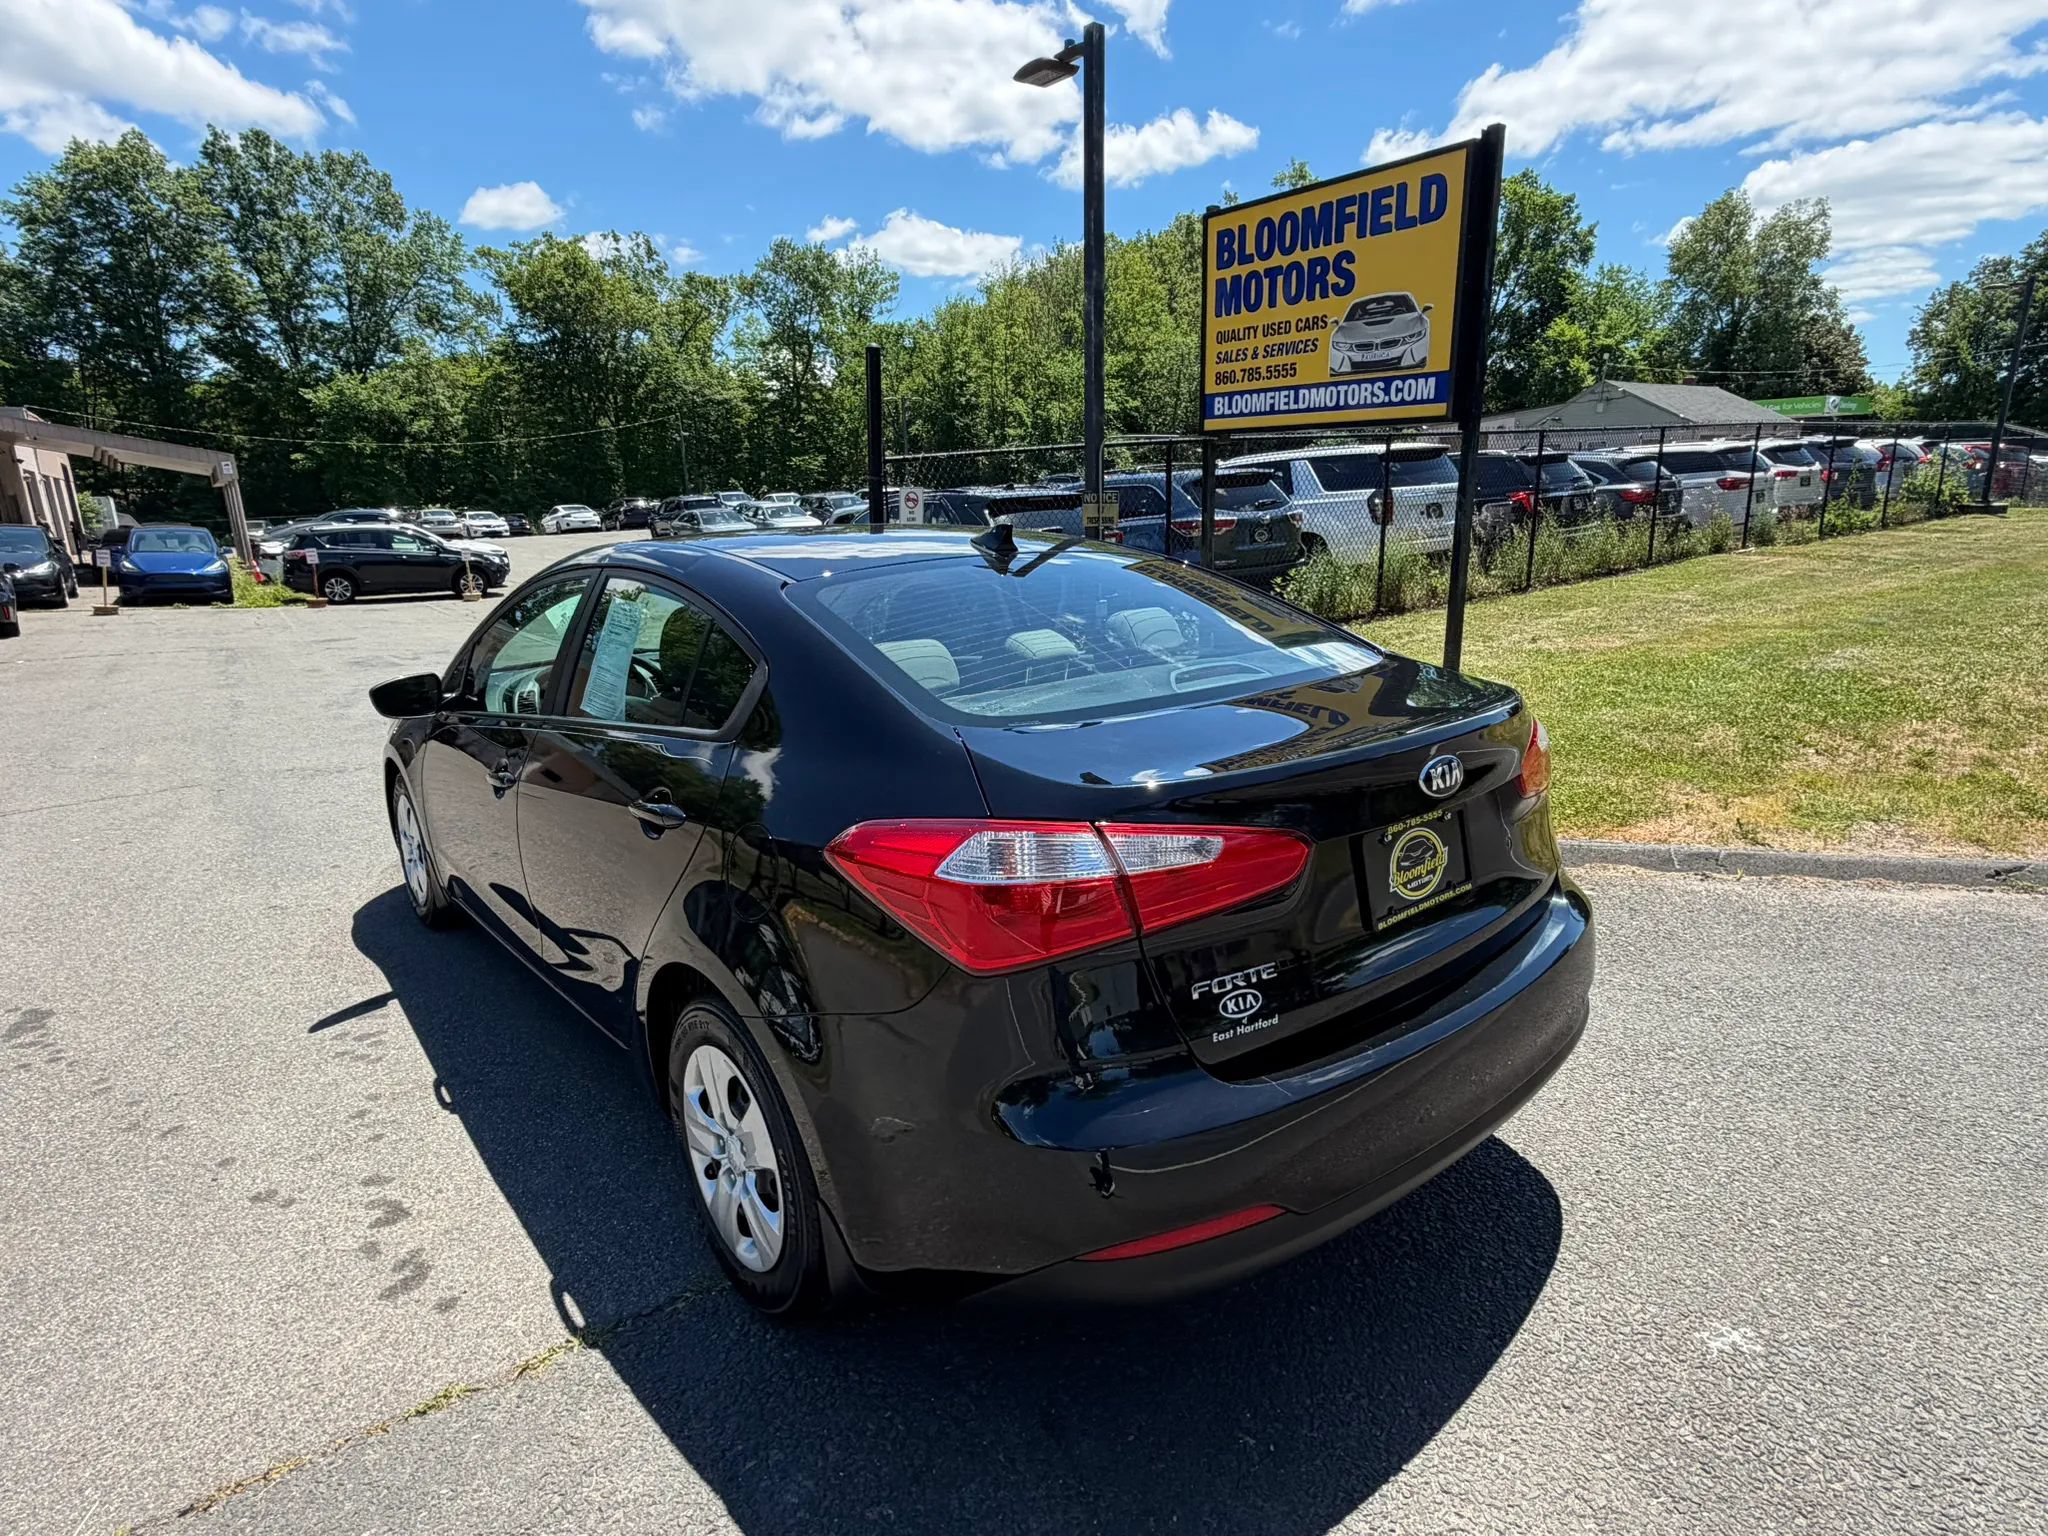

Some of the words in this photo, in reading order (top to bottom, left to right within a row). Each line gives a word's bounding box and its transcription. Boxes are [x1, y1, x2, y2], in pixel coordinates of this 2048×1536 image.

[1216, 172, 1448, 271] BLOOMFIELD
[1215, 249, 1356, 318] MOTORS
[1216, 325, 1259, 345] QUALITY
[1262, 320, 1292, 338] USED
[1295, 314, 1329, 333] CARS
[1215, 347, 1249, 365] SALES
[1251, 346, 1260, 360] &
[1262, 337, 1319, 359] SERVICES
[1215, 362, 1298, 386] 860.785.5555
[1214, 376, 1436, 416] BLOOMFIELDMOTORS.COM
[1429, 761, 1463, 791] KIA
[1387, 809, 1443, 835] 860-785-5555
[1393, 853, 1445, 887] Bloomfield
[1377, 883, 1473, 931] BLOOMFIELDMOTORS.COM
[1191, 962, 1278, 1000] FORTE
[1226, 994, 1257, 1014] KIA
[1212, 1030, 1234, 1043] East
[1236, 1013, 1279, 1036] Hartford
